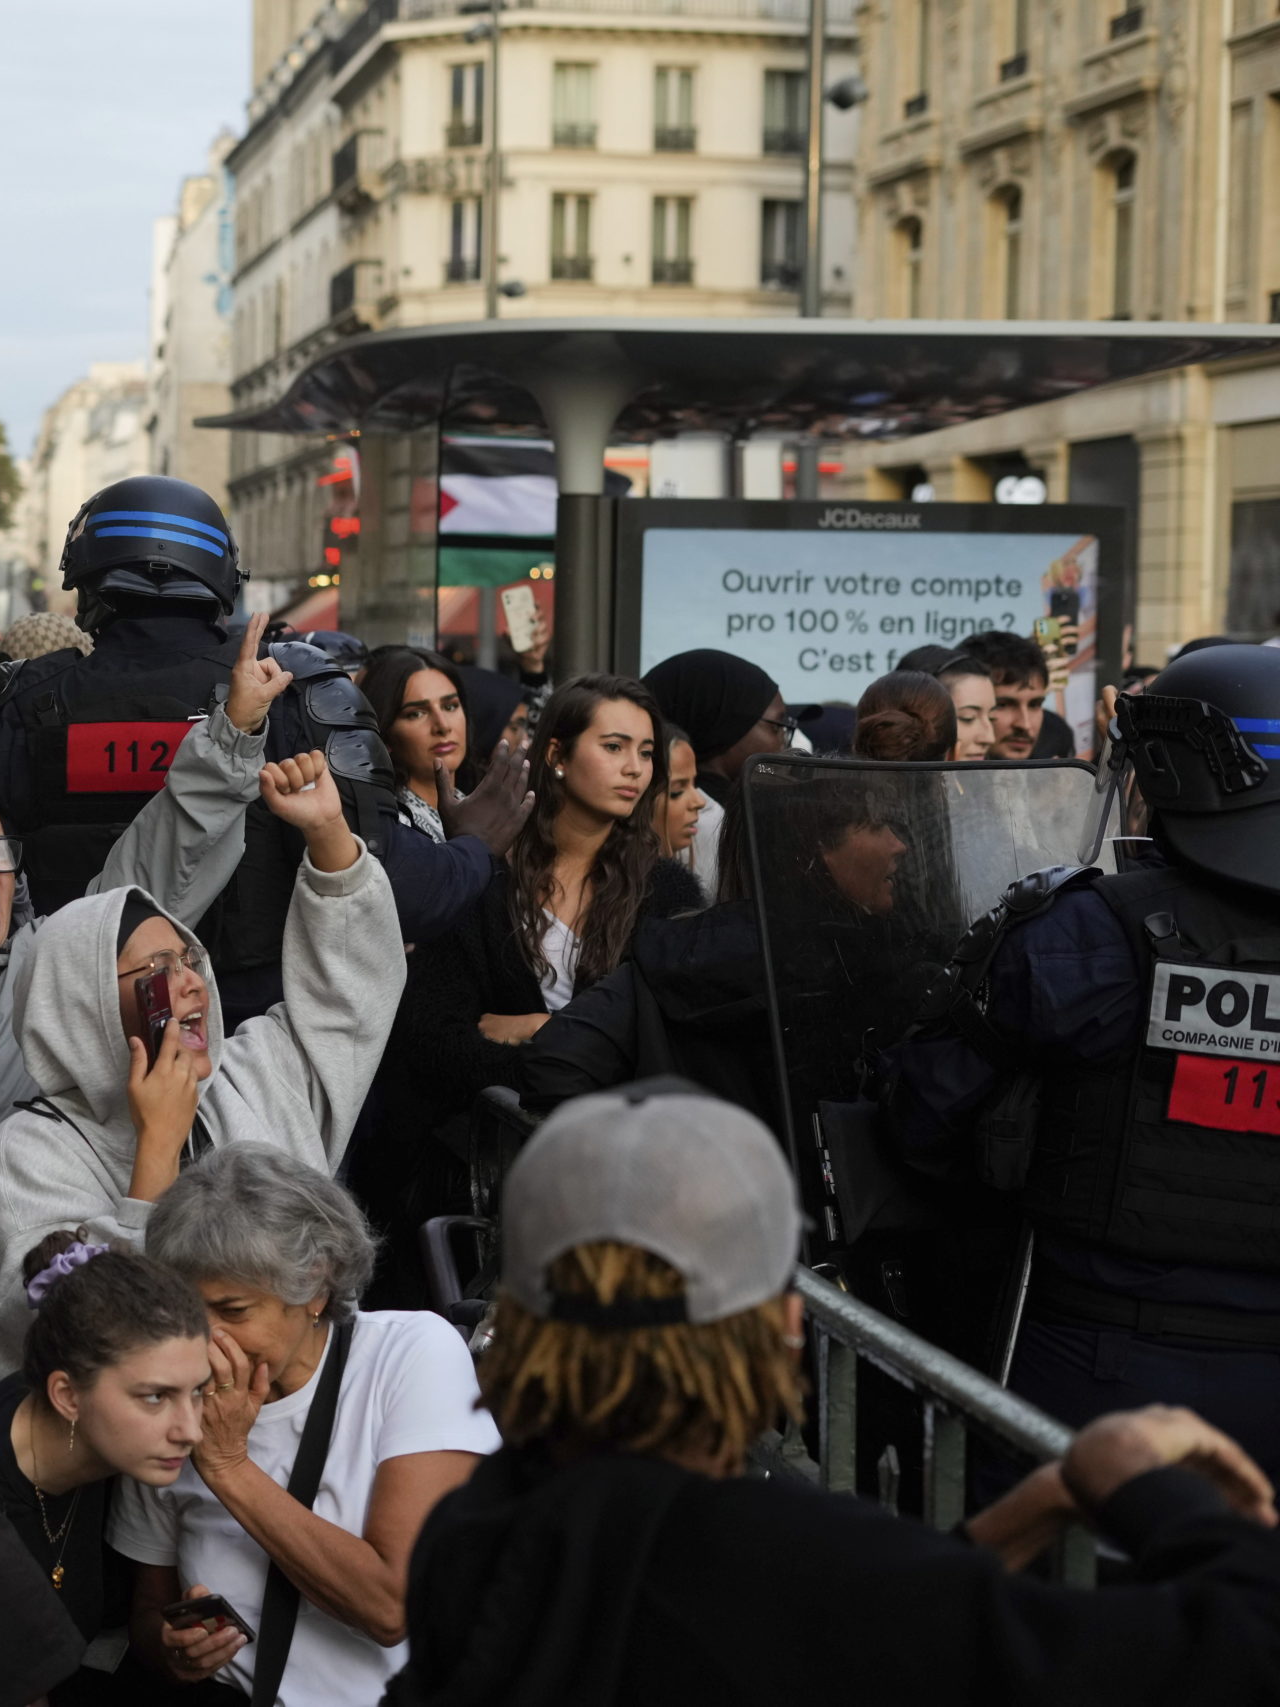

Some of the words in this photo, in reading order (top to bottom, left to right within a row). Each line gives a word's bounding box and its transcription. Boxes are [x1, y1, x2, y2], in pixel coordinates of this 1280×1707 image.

[818, 509, 921, 529] JCDecaux
[721, 569, 814, 595] Ouvrir
[825, 573, 900, 596] votre
[911, 573, 1022, 603] compte
[726, 613, 776, 637] pro
[880, 615, 914, 635] en
[104, 741, 169, 773] 112
[1162, 1029, 1254, 1051] COMPAGNIE
[1259, 1039, 1280, 1054] D'I
[1224, 1066, 1280, 1108] 11
